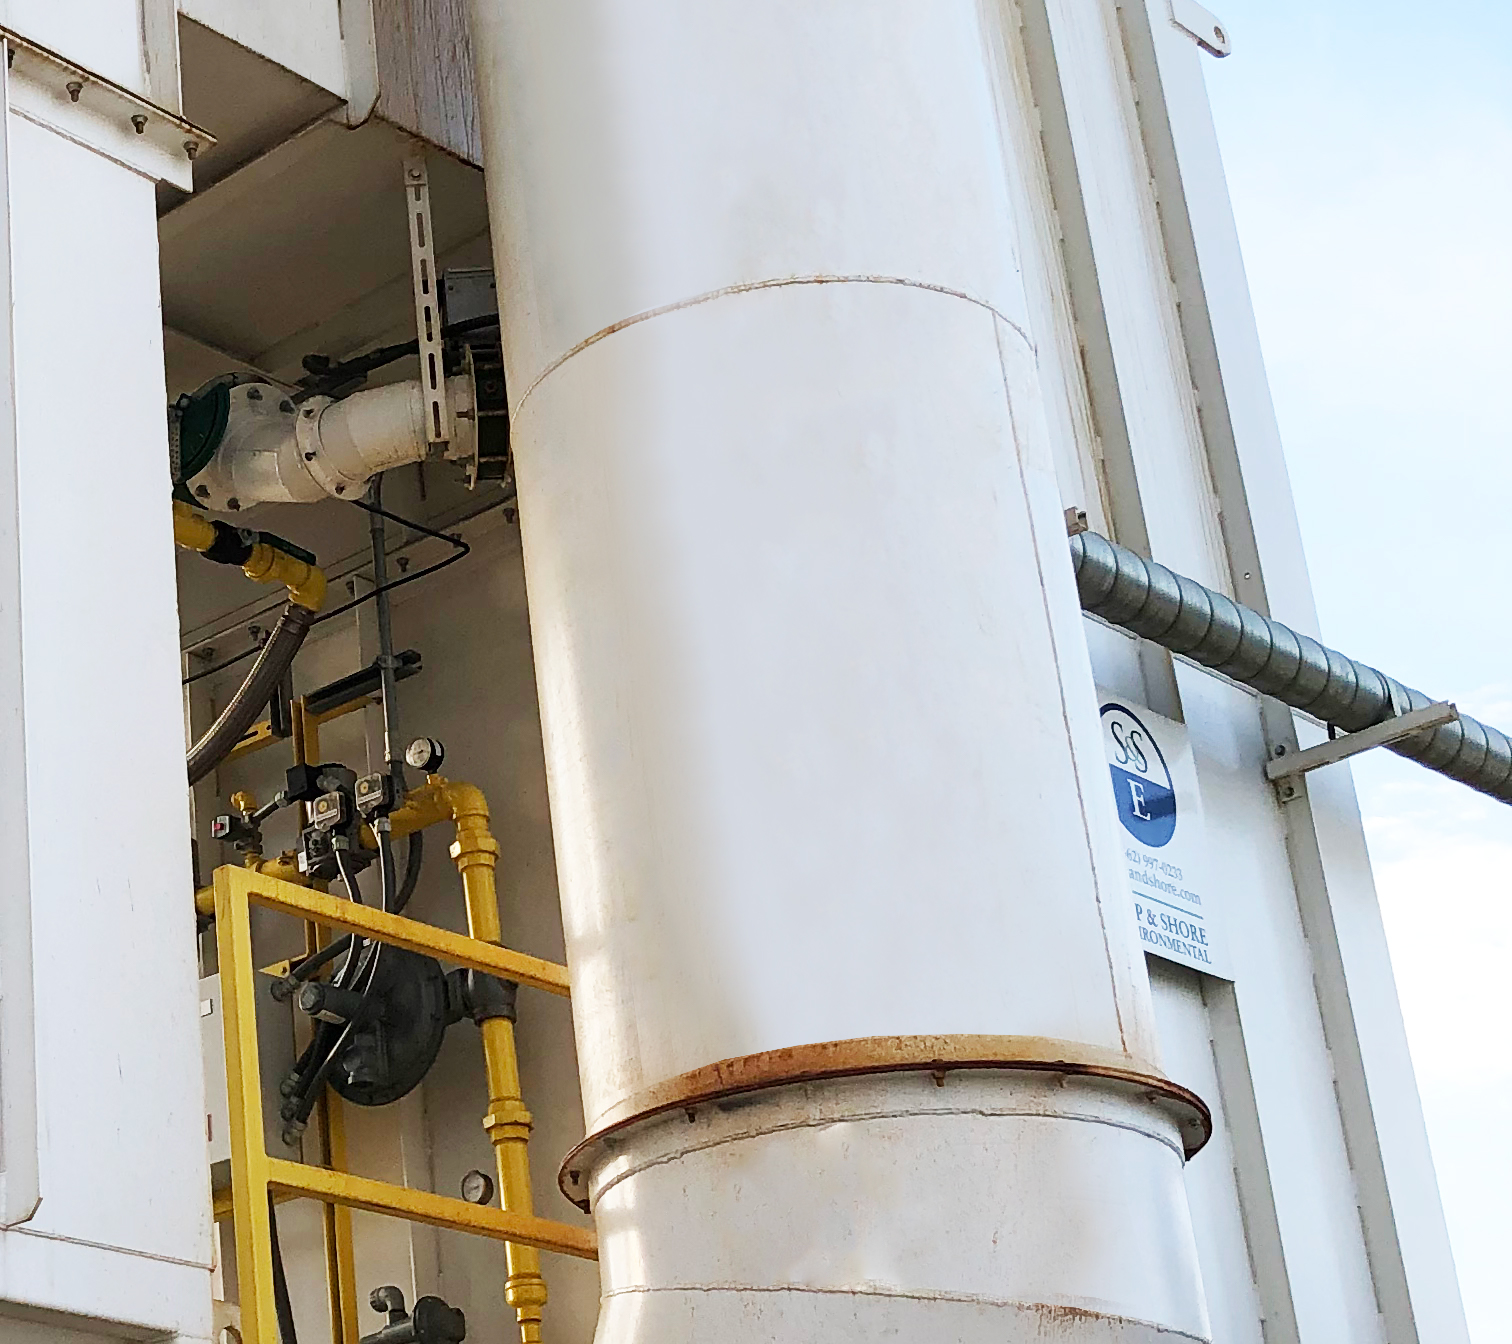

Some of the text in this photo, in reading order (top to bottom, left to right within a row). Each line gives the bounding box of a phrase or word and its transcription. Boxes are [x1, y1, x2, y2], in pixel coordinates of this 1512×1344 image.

[1127, 778, 1151, 821] E
[1146, 908, 1158, 928] &
[1159, 912, 1209, 947] SHORE
